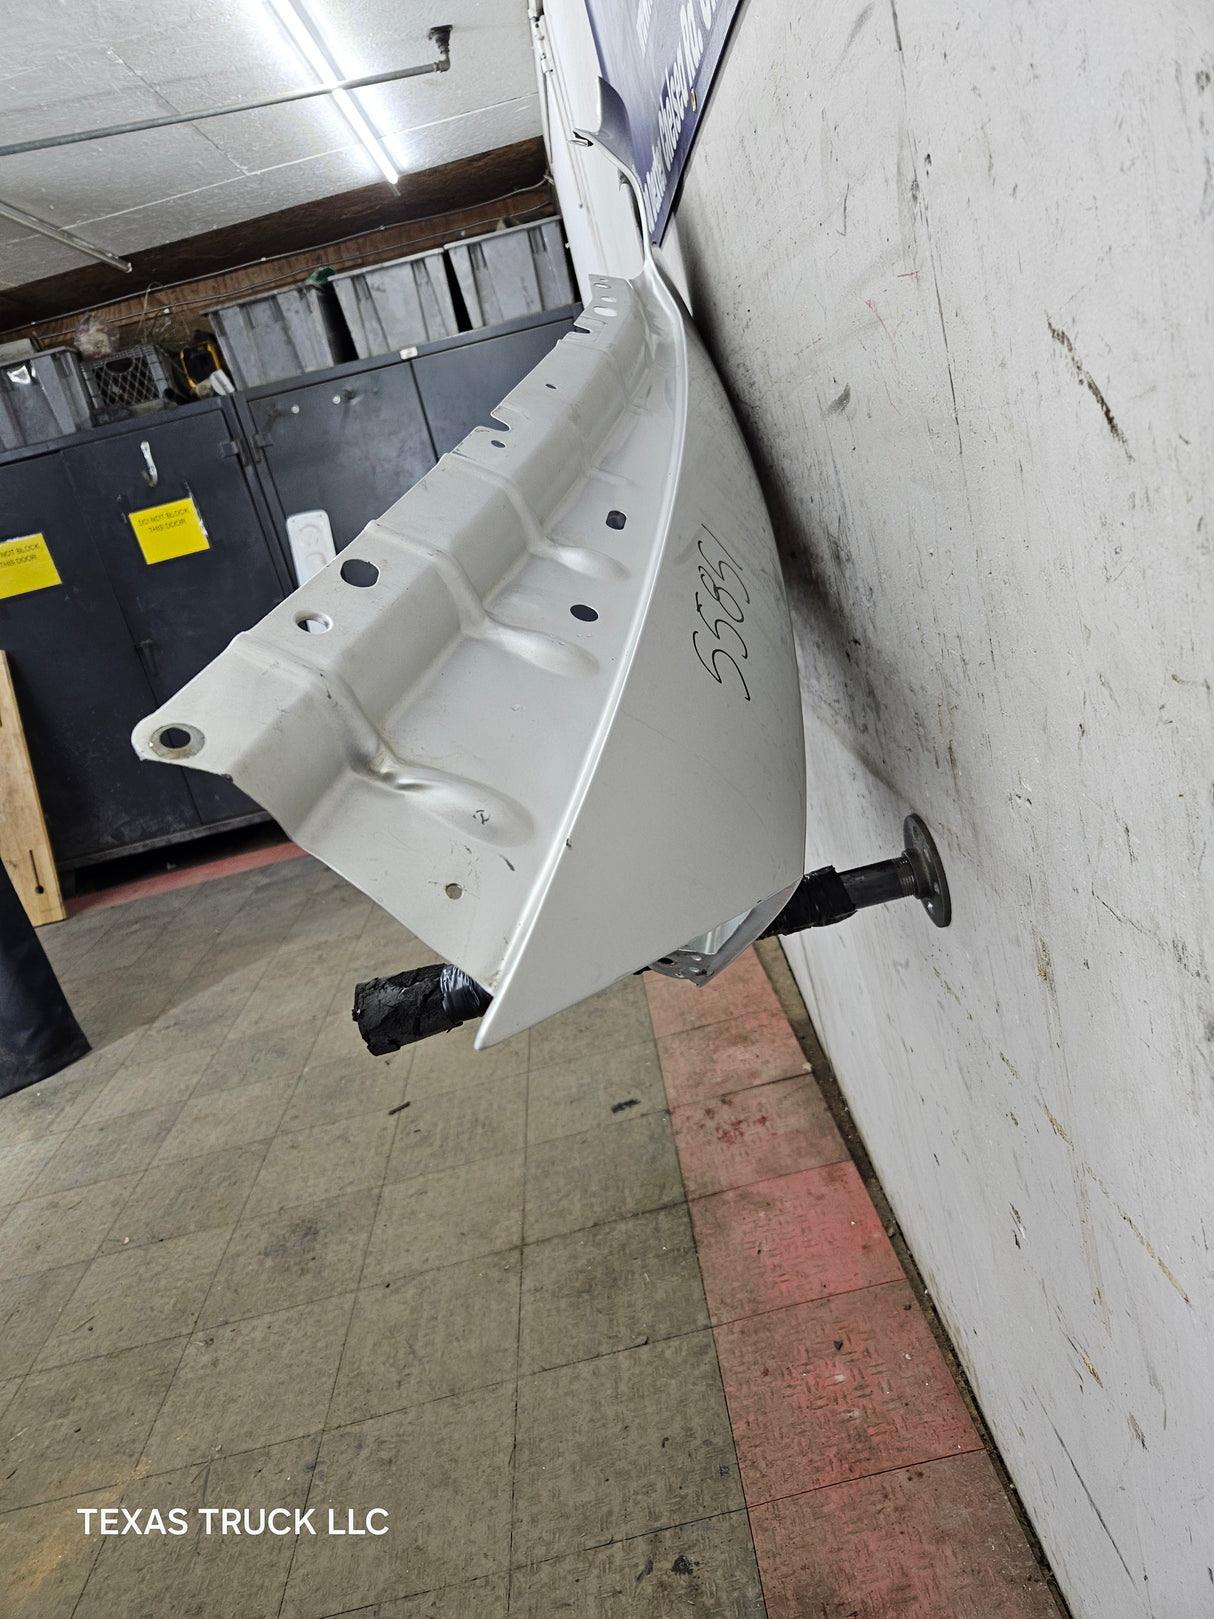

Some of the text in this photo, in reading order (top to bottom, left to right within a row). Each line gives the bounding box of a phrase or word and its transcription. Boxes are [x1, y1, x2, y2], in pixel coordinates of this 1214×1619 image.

[658, 42, 688, 173] Chelsea
[138, 508, 189, 526] DO NOT BLOCK
[149, 524, 164, 533] THIS
[0, 543, 40, 557] NOT BLOCK
[0, 559, 16, 567] THIS
[692, 523, 751, 702] 55851
